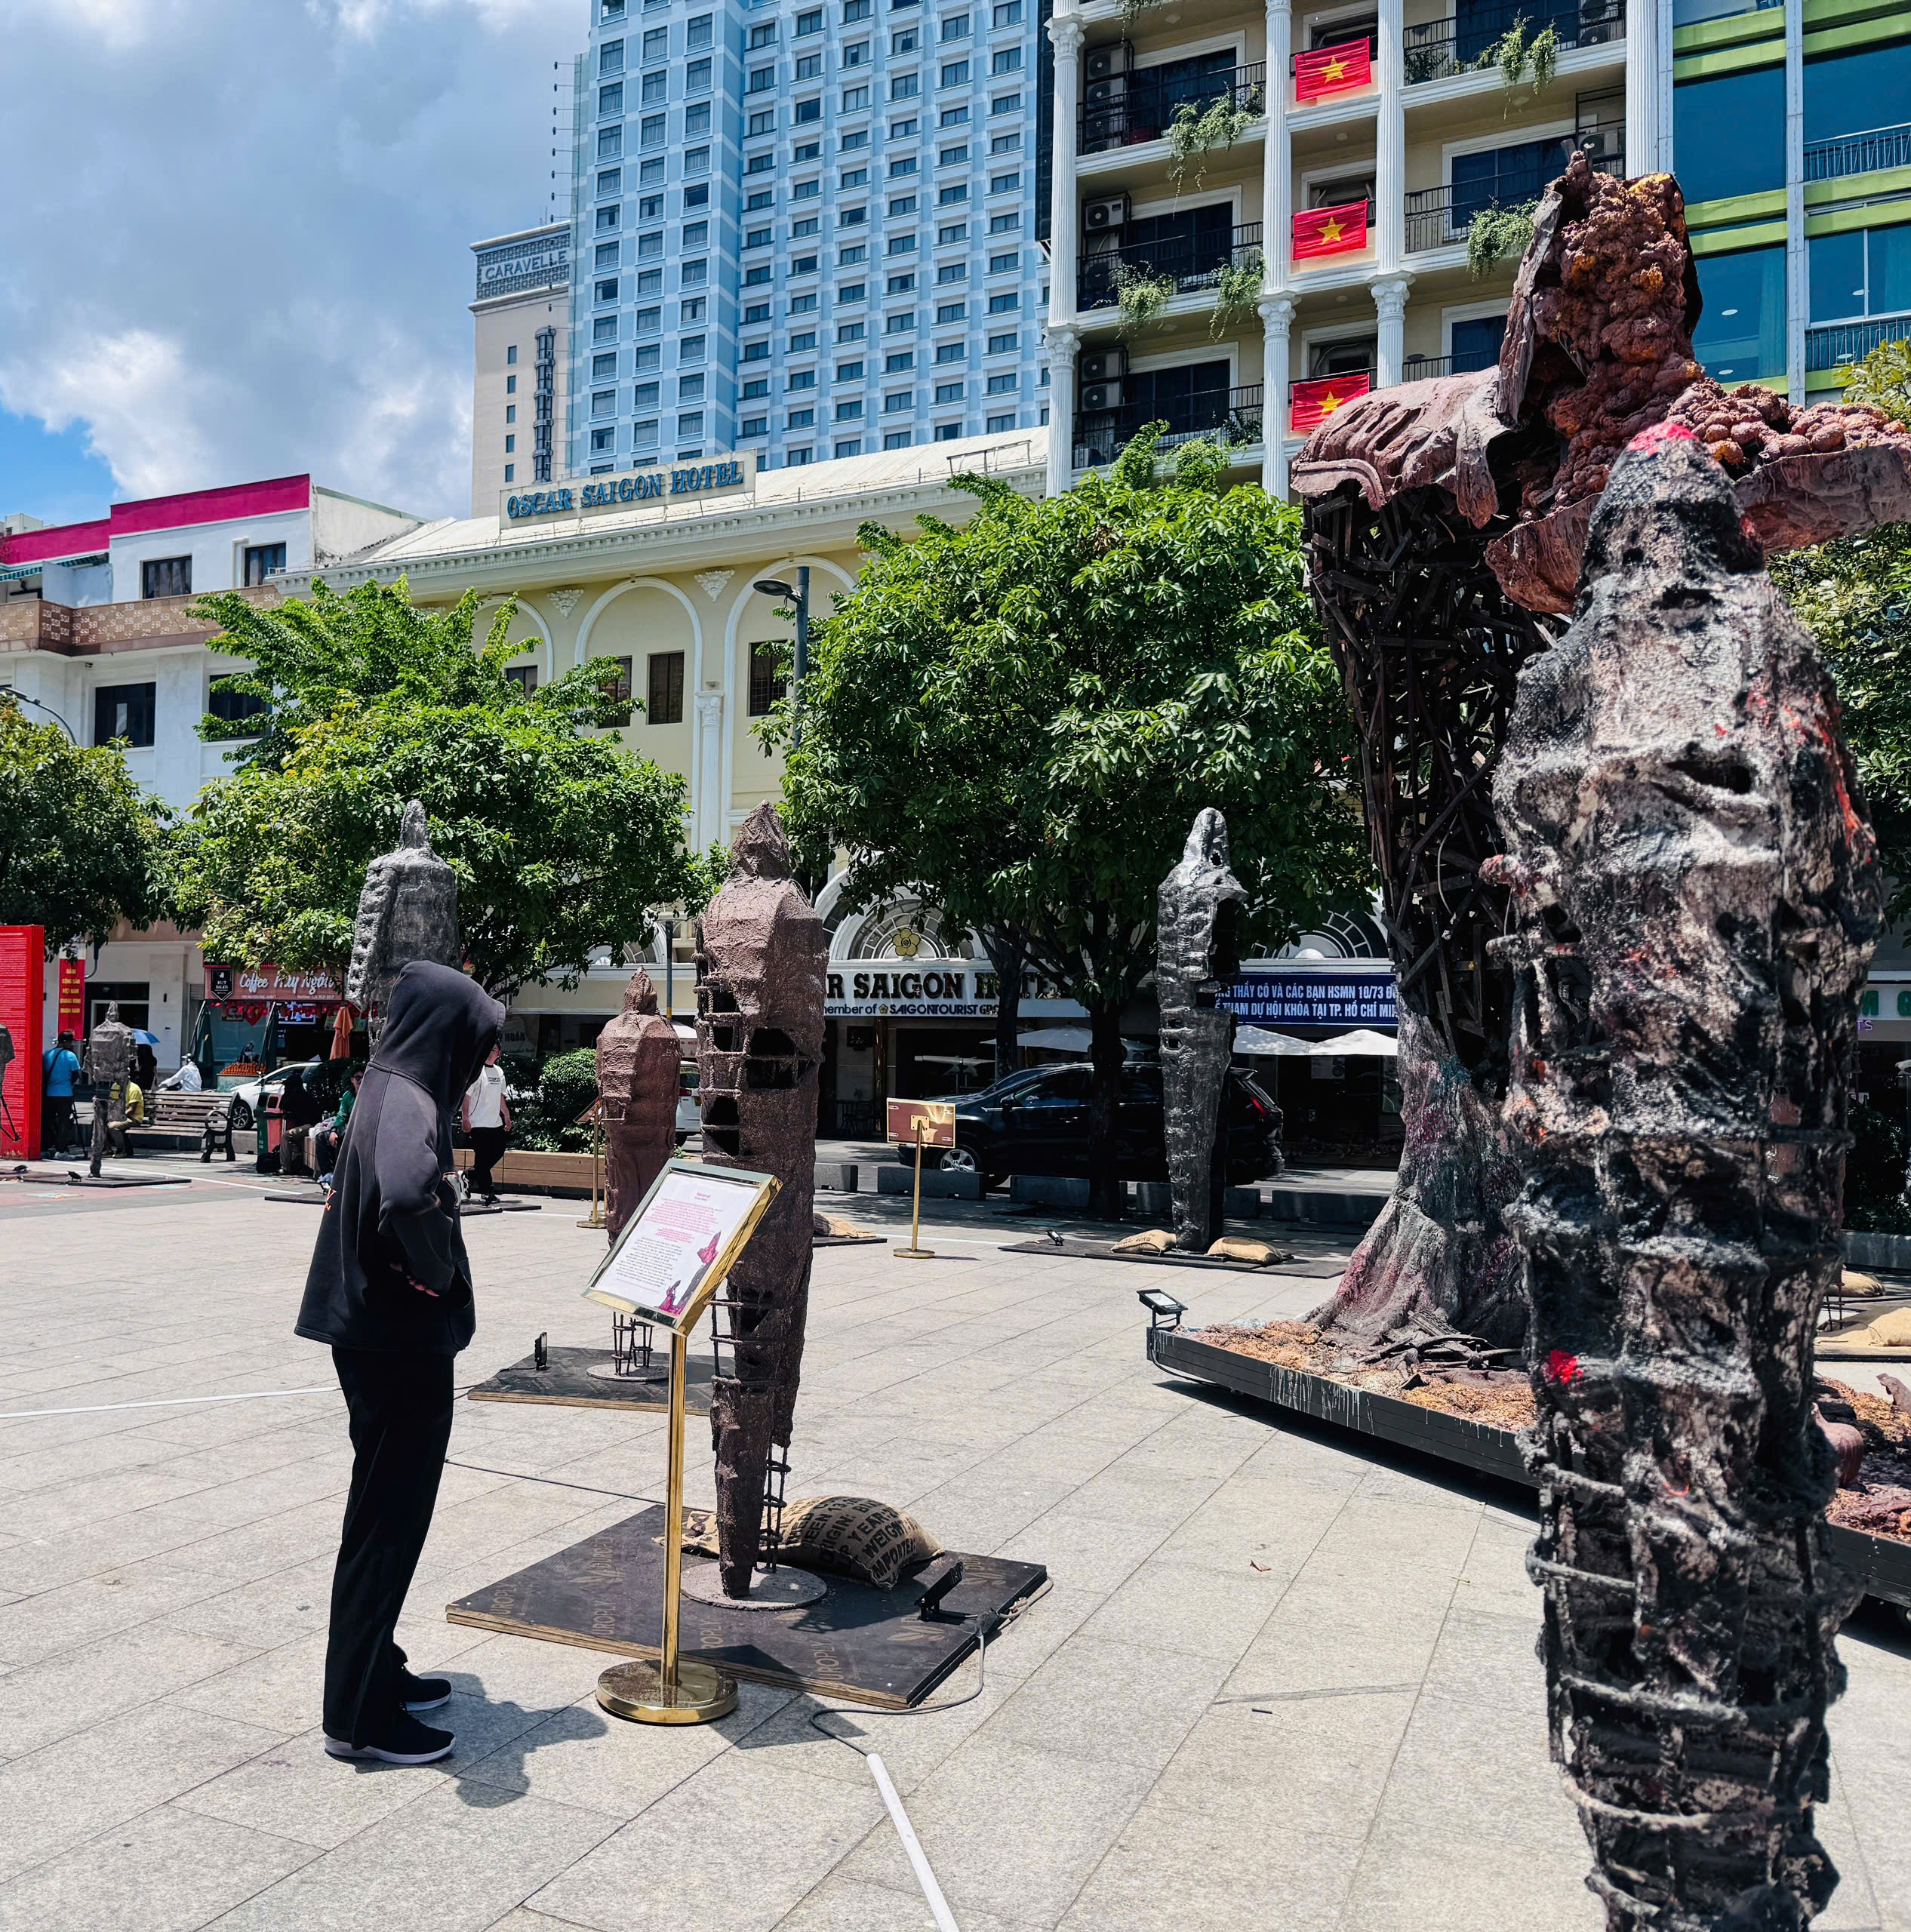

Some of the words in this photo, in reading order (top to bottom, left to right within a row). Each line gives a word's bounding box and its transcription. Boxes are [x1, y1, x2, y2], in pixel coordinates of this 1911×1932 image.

[485, 250, 568, 280] CARAVELLE
[507, 488, 572, 519] OSCAR
[580, 473, 663, 508] SAIGON
[670, 461, 743, 494] HOTEL
[239, 973, 269, 993] Coffee
[854, 972, 965, 999] SAIGON
[1257, 983, 1269, 998] CÔ
[1271, 983, 1283, 998] VÀ
[1286, 983, 1303, 998] CÁC
[1306, 986, 1325, 1001] BẠN
[1328, 986, 1356, 998] HSMN
[1359, 986, 1383, 999] 10/73
[865, 1003, 877, 1015] of
[889, 1003, 978, 1015] SAIGONTOURIST
[1251, 1001, 1265, 1018] DỰ
[1266, 1000, 1282, 1019] HỘI
[1284, 1001, 1309, 1016] KHÓA
[1312, 1004, 1327, 1019] TẠI
[1329, 1004, 1342, 1017] TP.
[1344, 1000, 1358, 1017] HỒ
[1360, 1001, 1377, 1017] CHÍ
[1857, 1020, 1873, 1031] TS
[490, 1582, 517, 1615] UROPLY
[591, 1600, 617, 1637] UROPLY
[810, 1637, 844, 1680] UROPLY
